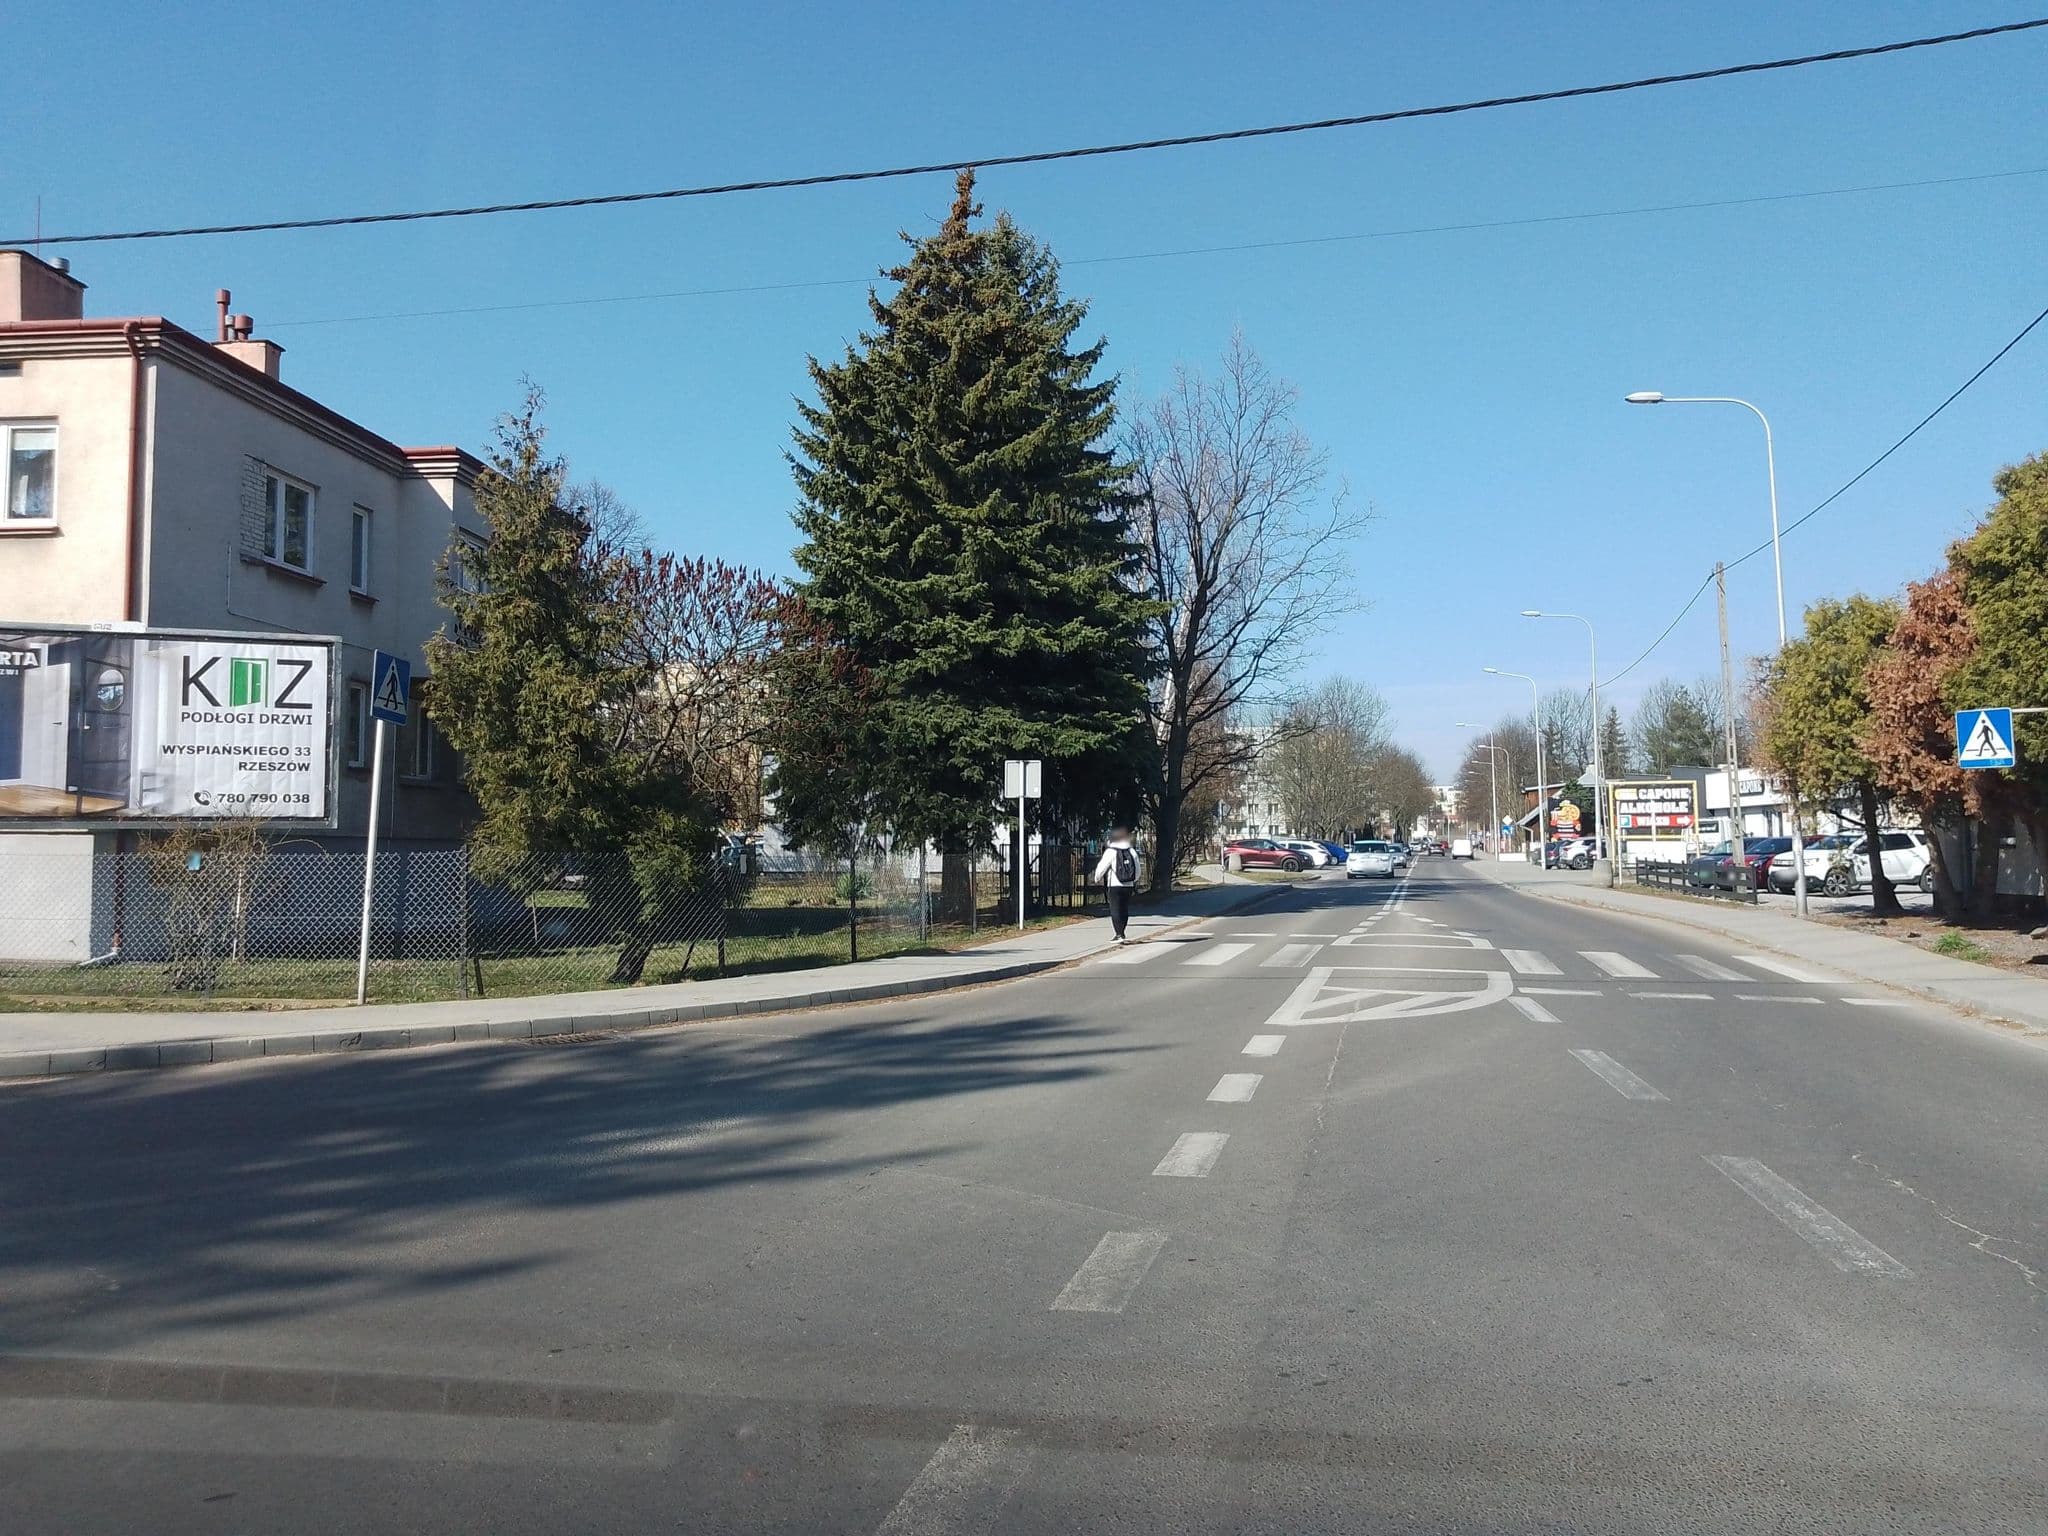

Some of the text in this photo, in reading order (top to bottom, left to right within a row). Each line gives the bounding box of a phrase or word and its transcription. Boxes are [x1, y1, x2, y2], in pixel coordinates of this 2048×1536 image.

[181, 712, 312, 725] PODŁOGI DRZWI
[162, 744, 311, 756] WYSPIAŃSKIEGO 33
[238, 760, 310, 771] RZESZÓW
[217, 794, 310, 803] 780 790 038
[1639, 788, 1689, 800] CAPONE
[1620, 801, 1688, 813] ALKOHOLE
